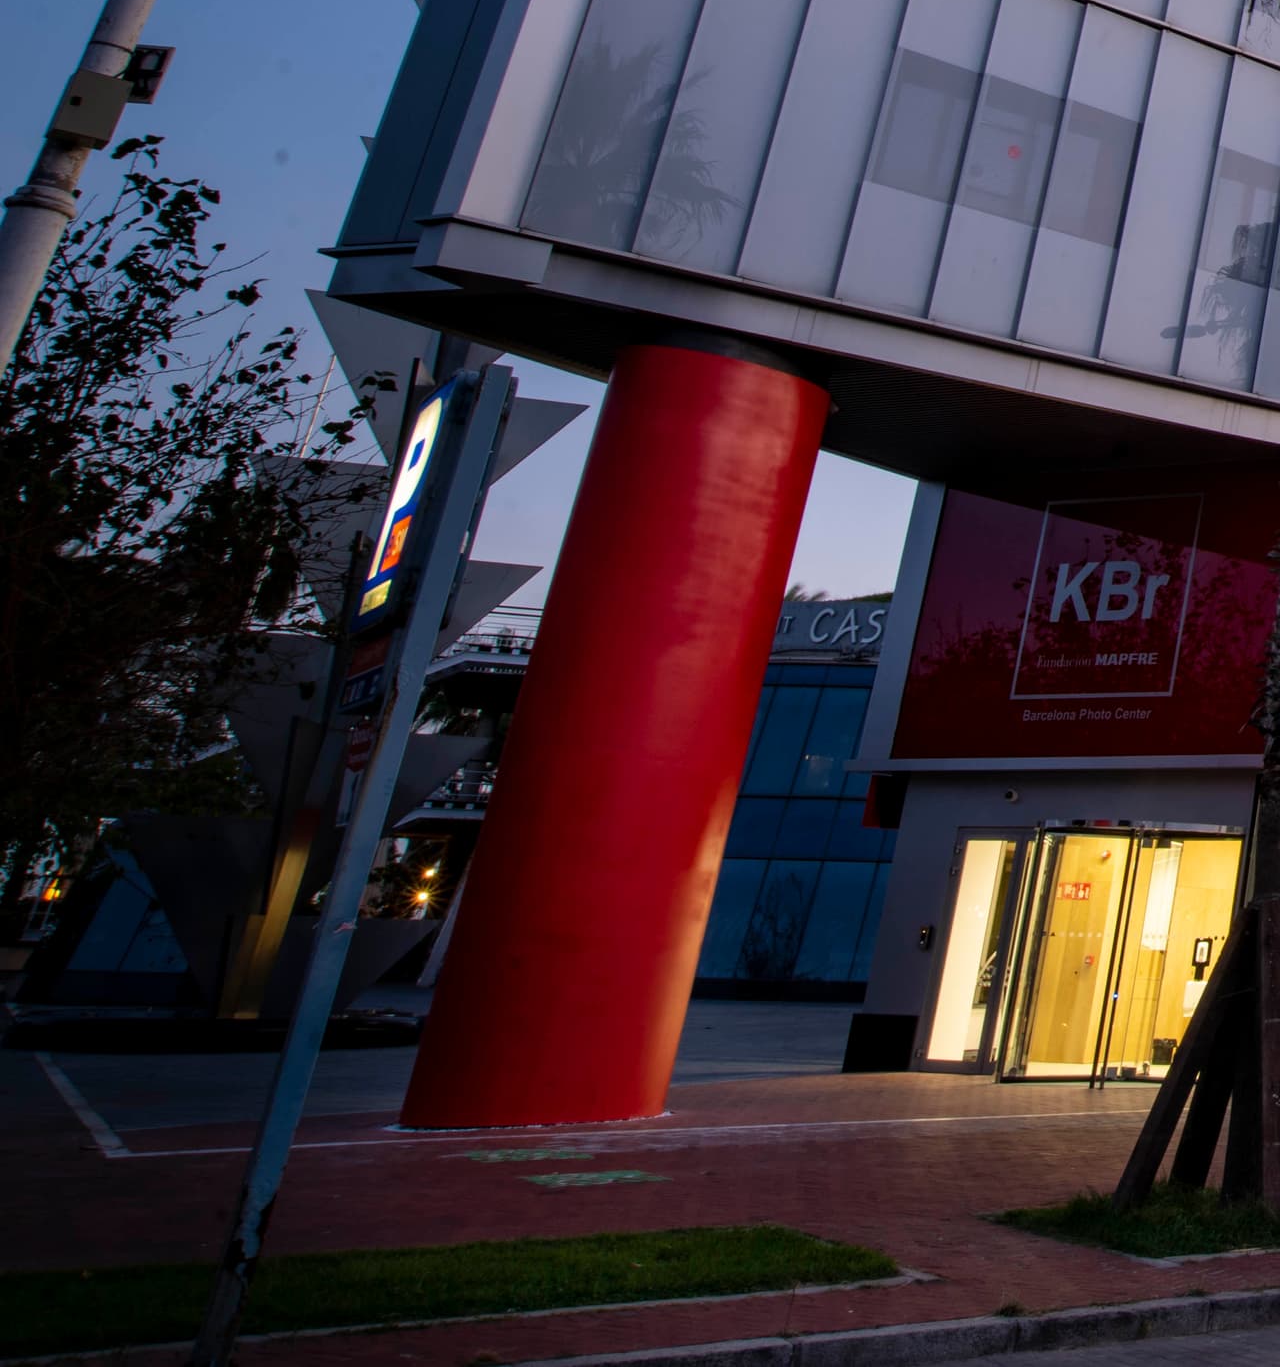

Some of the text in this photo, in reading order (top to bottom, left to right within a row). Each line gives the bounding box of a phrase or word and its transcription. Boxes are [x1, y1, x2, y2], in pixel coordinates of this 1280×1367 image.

[368, 397, 443, 581] P
[1050, 560, 1171, 623] KBr
[1095, 652, 1159, 666] MAPFRE
[1023, 707, 1152, 721] Barcelona Photo Center
